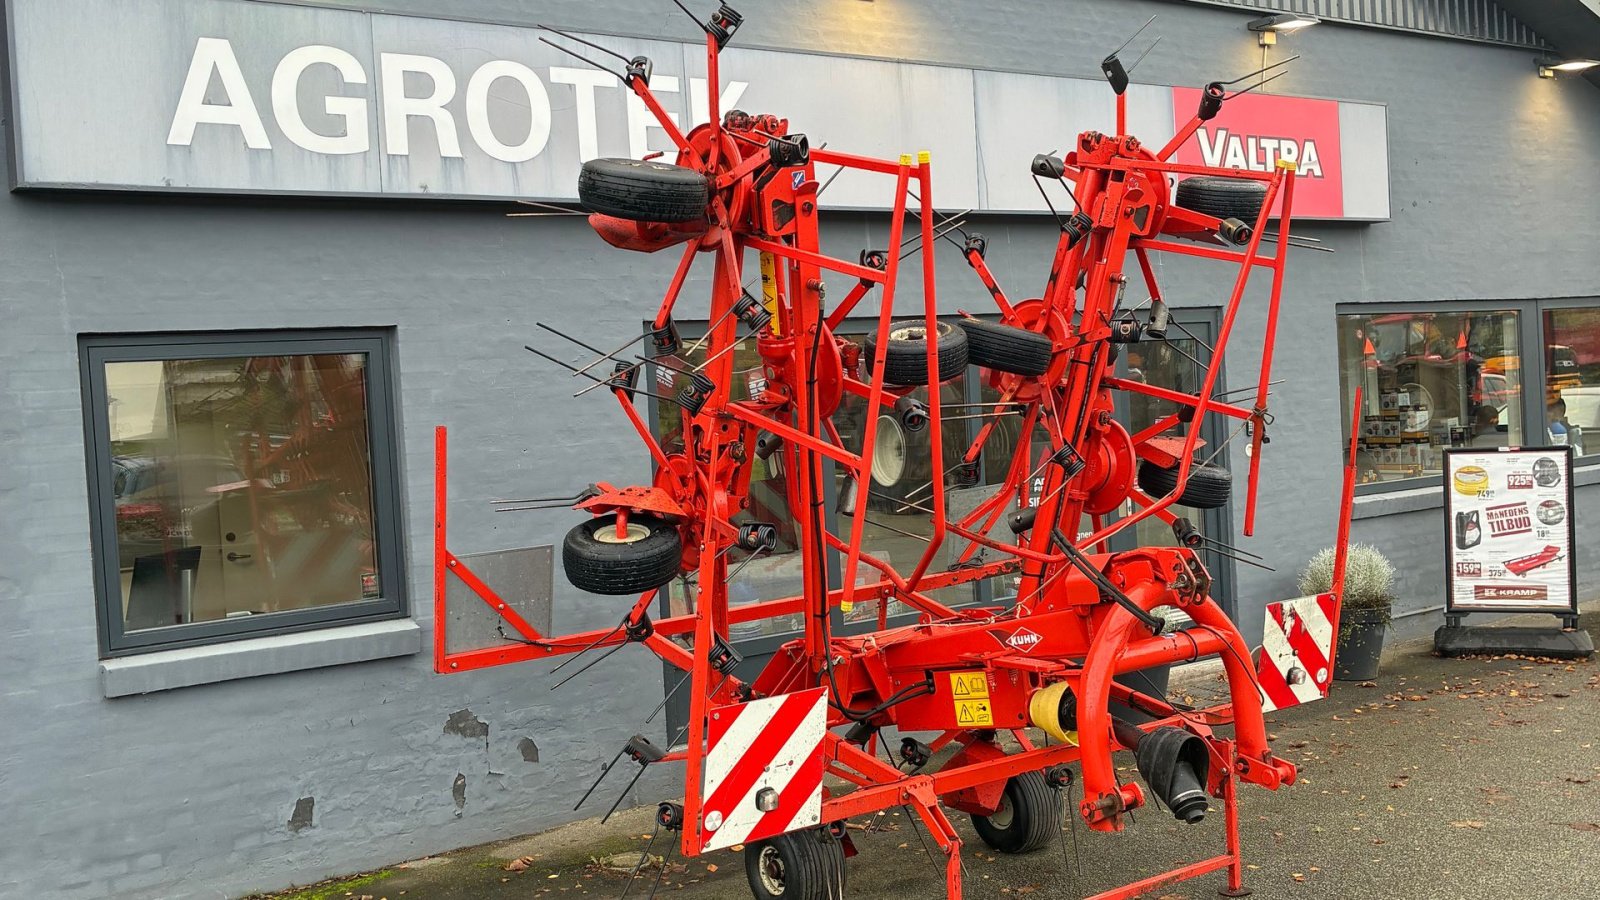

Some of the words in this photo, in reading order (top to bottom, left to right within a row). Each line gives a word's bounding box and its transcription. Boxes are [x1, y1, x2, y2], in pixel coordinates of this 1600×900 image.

[1197, 126, 1324, 178] VALTRA
[1508, 475, 1527, 486] 925
[1486, 507, 1529, 520] MÅNEDENS
[1488, 516, 1531, 533] TILBUD
[1011, 634, 1038, 645] KUHN
